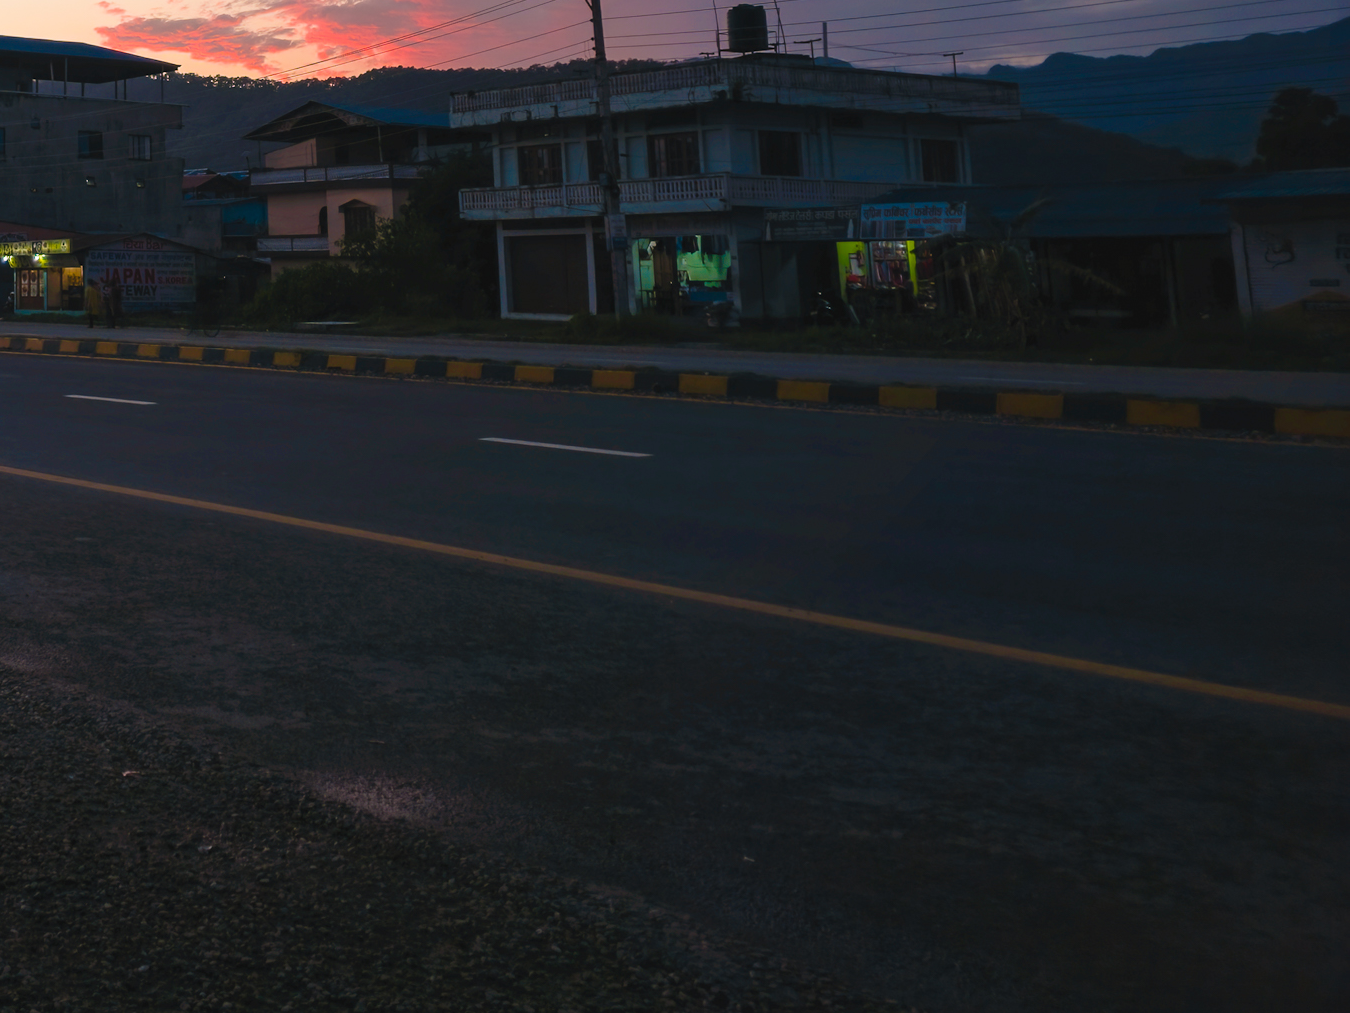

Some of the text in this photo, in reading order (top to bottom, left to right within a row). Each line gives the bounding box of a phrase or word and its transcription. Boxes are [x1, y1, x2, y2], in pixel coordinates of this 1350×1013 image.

[146, 238, 167, 249] Bar
[90, 252, 132, 260] SAFEWAY
[100, 268, 155, 284] JAPAN
